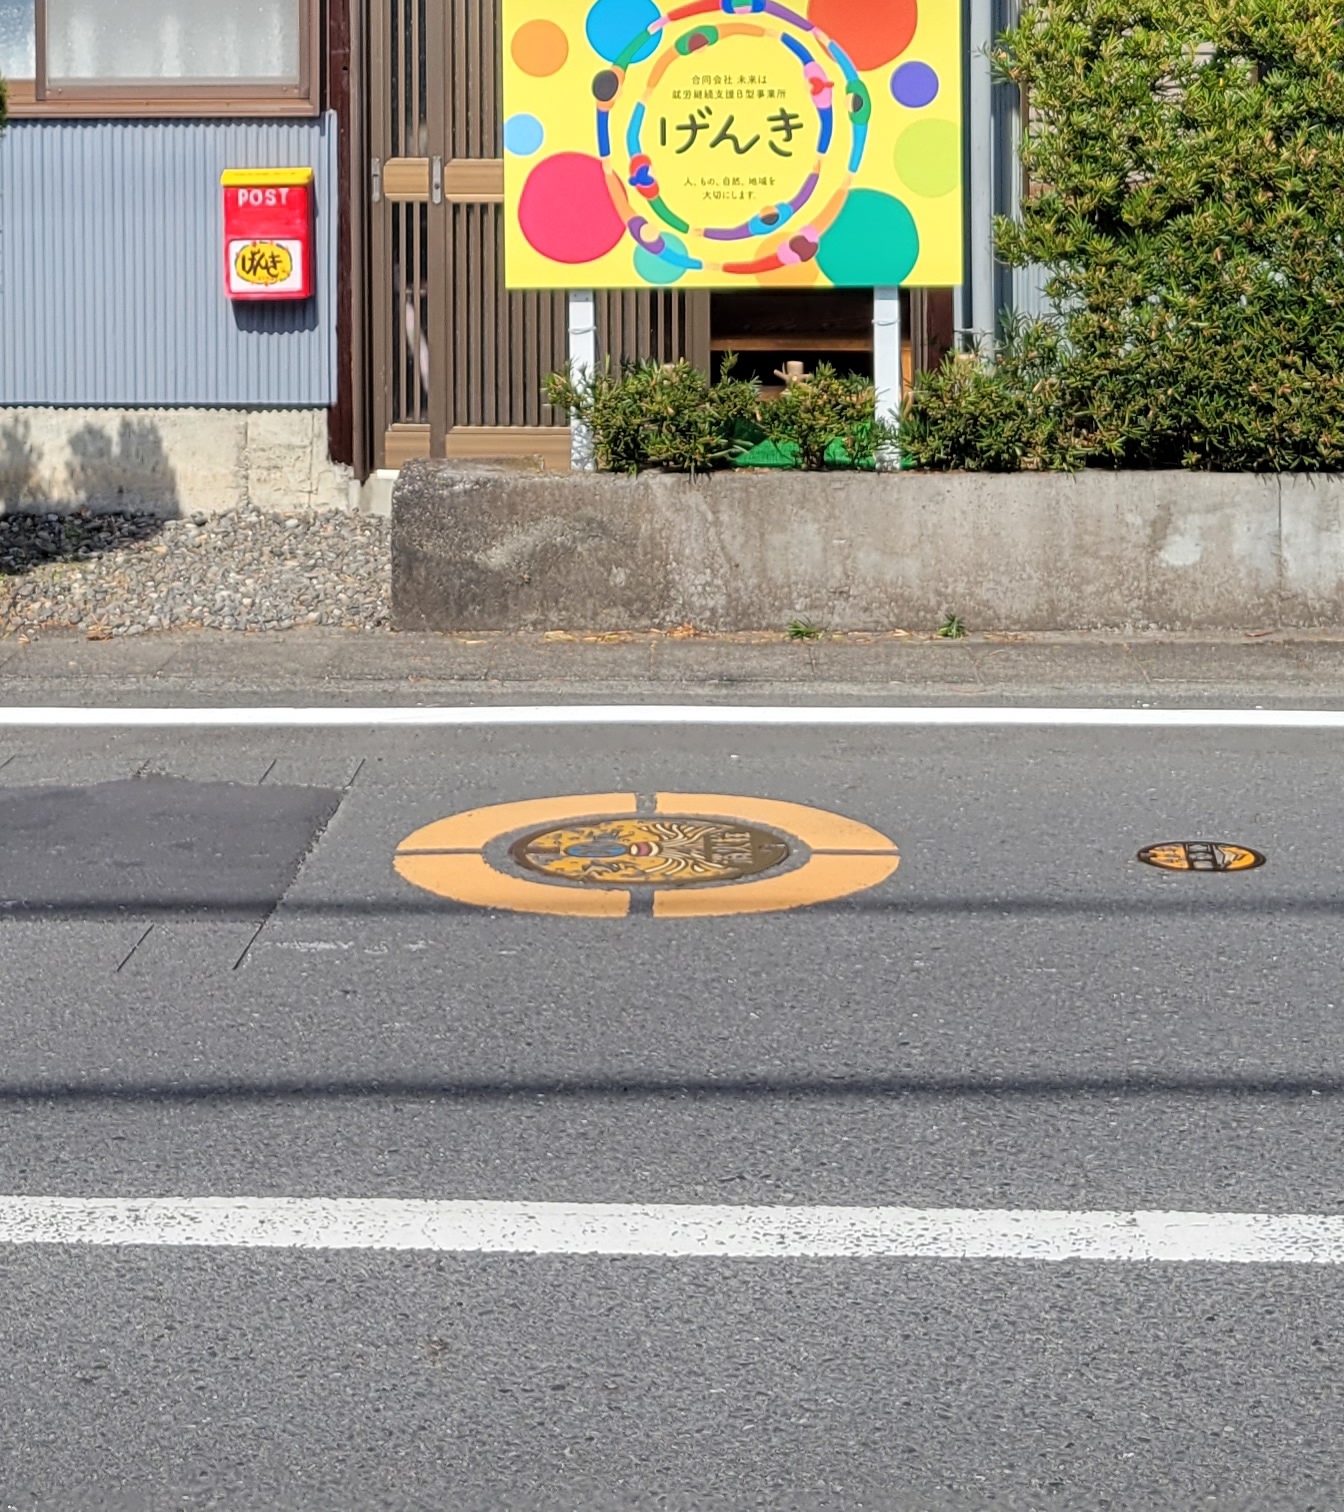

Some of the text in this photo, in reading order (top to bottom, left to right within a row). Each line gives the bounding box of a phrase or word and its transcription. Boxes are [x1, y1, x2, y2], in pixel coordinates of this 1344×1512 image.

[691, 74, 767, 85] 合同会社 未来は
[672, 89, 786, 100] 就労継続支援B型事業所
[659, 106, 804, 157] げんき
[238, 188, 289, 207] POST
